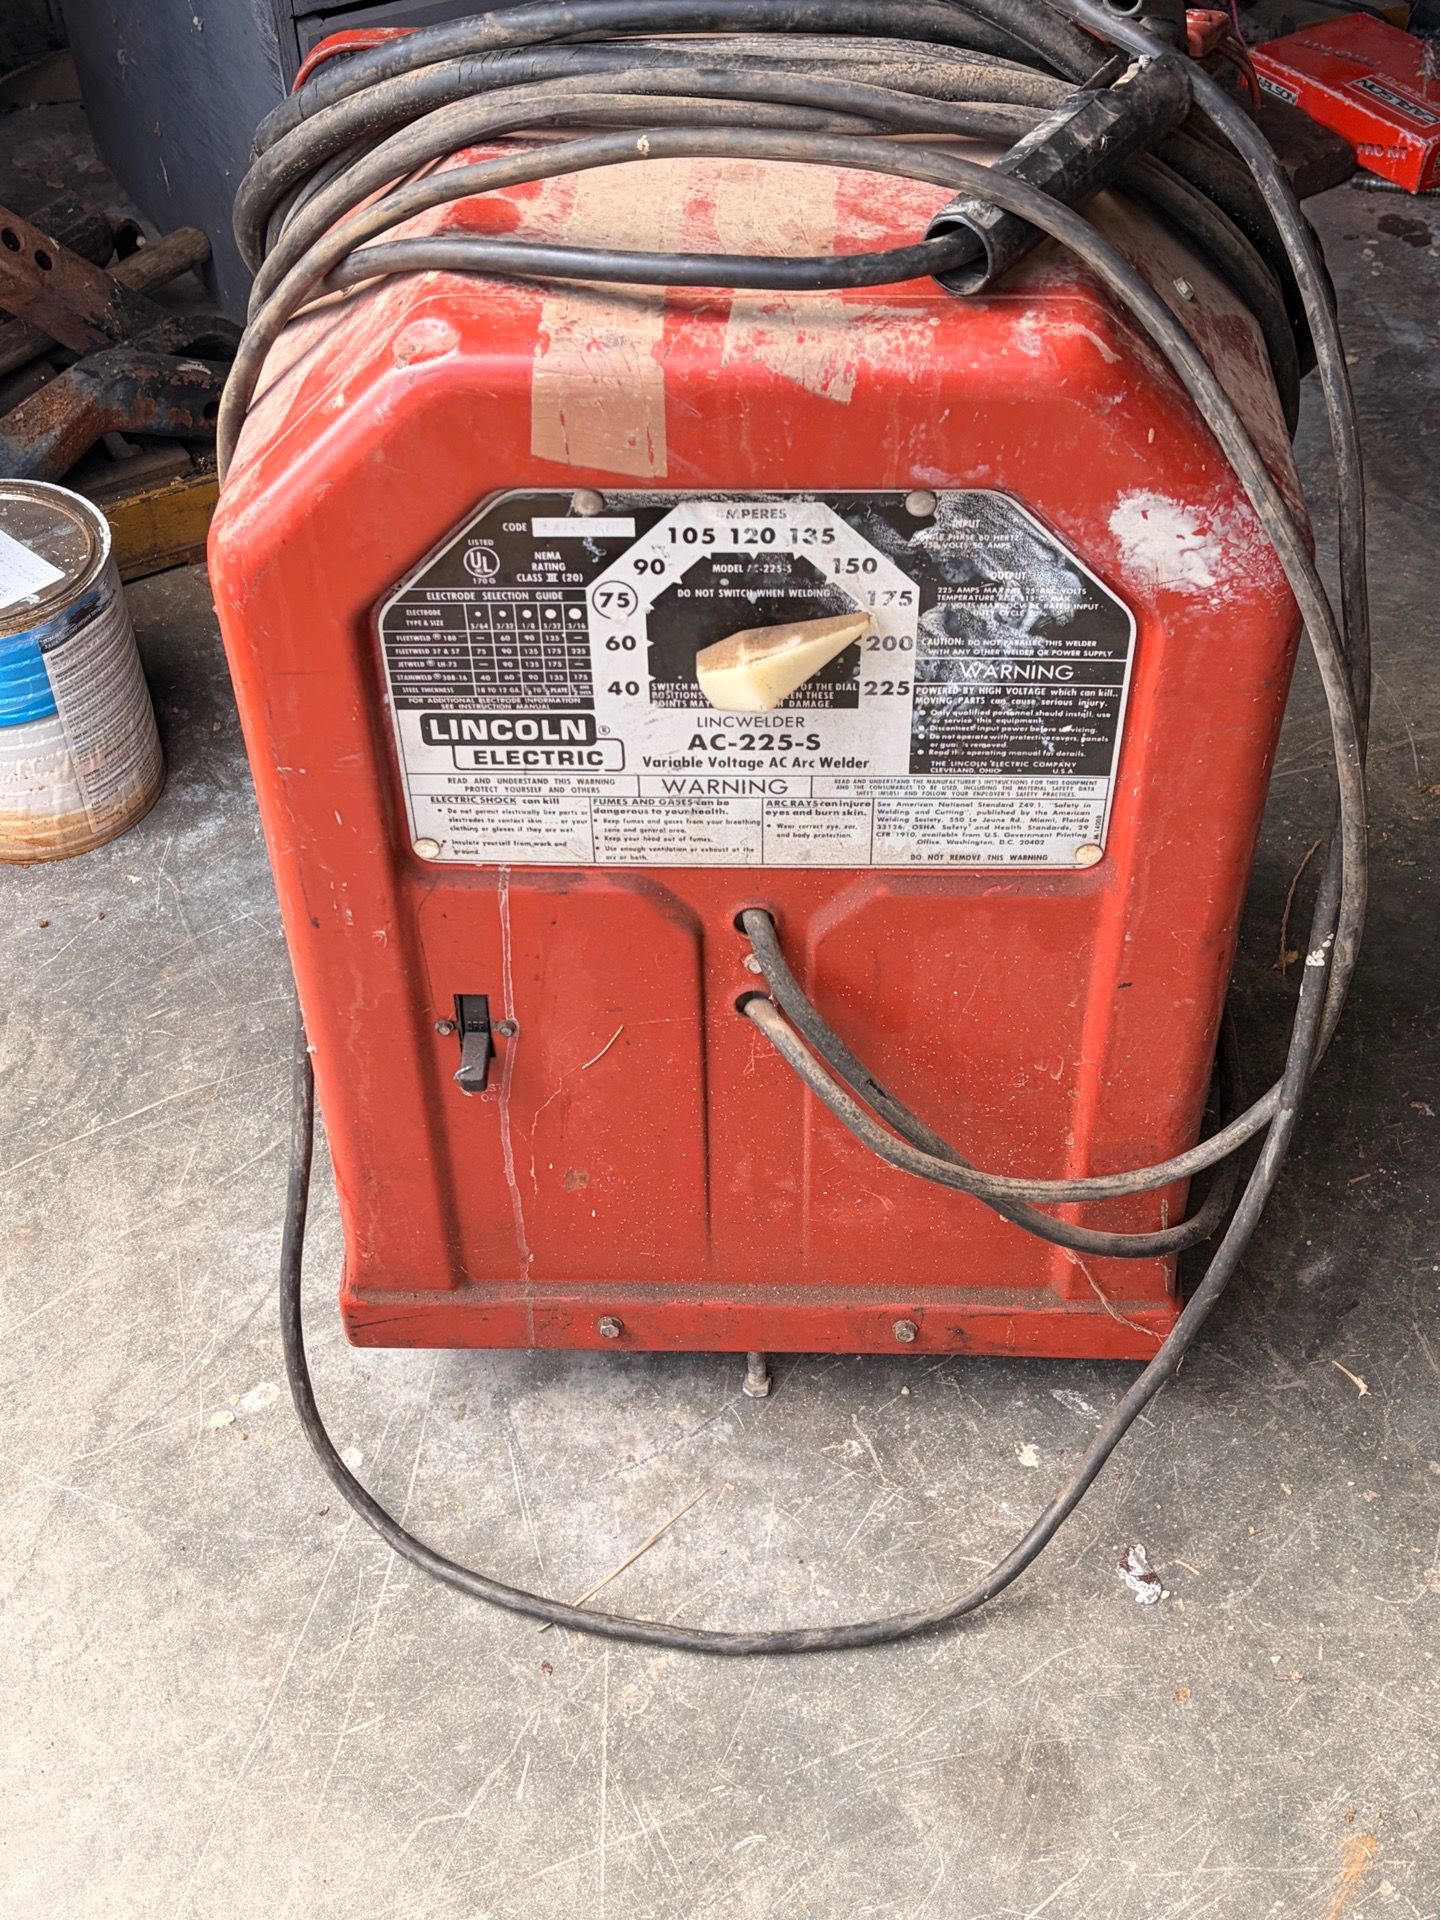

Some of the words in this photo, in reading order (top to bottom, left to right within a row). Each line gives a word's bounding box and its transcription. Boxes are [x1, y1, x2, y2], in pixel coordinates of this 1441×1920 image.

[1357, 142, 1384, 157] PRO
[502, 523, 527, 532] CODE
[668, 527, 715, 544] 105
[731, 527, 776, 544] 120
[790, 528, 836, 545] 135
[534, 551, 561, 560] NEMA
[469, 552, 493, 573] UL
[531, 562, 566, 571] RATING
[633, 559, 665, 575] 90
[832, 558, 877, 574] 150
[712, 564, 743, 573] MODEL
[516, 574, 543, 582] CLASS
[562, 573, 583, 583] (20)
[991, 572, 1026, 580] OUTPUT
[426, 592, 476, 600] ELECTRODE
[482, 592, 529, 600] SELECTION
[536, 592, 563, 600] GUIDE
[677, 589, 691, 598] DO
[695, 589, 714, 598] NOT
[718, 589, 753, 598] SWITCH
[756, 589, 785, 598] WHEN
[789, 589, 830, 598] WELDING
[867, 590, 912, 607] 175
[600, 592, 630, 608] 75
[605, 635, 637, 650] 60
[866, 636, 914, 651] 200
[921, 638, 964, 646] CAUTION:
[960, 662, 1074, 680] WARNING
[607, 681, 640, 696] 40
[651, 682, 688, 691] SWITCH
[835, 683, 858, 691] DIAL
[864, 680, 910, 696] 225
[916, 687, 960, 695] POWERED
[963, 687, 974, 695] BY
[979, 687, 1001, 695] HIGH
[1006, 687, 1046, 696] VOLTAGE
[1051, 688, 1077, 696] which
[805, 692, 834, 700] THESE
[652, 700, 687, 708] POINTS
[788, 700, 833, 708] DAMAGE.
[916, 697, 955, 705] MOVING
[1042, 698, 1072, 706] serious
[1078, 699, 1108, 708] injury.
[696, 716, 805, 728] LINCWELDER
[429, 719, 587, 740] LINCOLN
[687, 734, 821, 751] AC-225-S
[473, 750, 604, 766] ELECTRIC
[642, 756, 703, 769] Variable
[707, 756, 764, 770] Voltage
[768, 757, 788, 769] AC
[792, 757, 817, 769] Arc
[819, 756, 870, 769] Welder
[662, 778, 789, 794] WARNING
[430, 796, 476, 804] ELECTRIC
[593, 798, 628, 806] FUMES
[632, 798, 655, 806] AND
[766, 800, 789, 808] ARC
[790, 800, 818, 808] RAYS
[839, 800, 871, 809] injure
[593, 808, 649, 817] dangerous
[664, 809, 690, 817] your
[691, 808, 729, 816] health.
[793, 808, 812, 816] and
